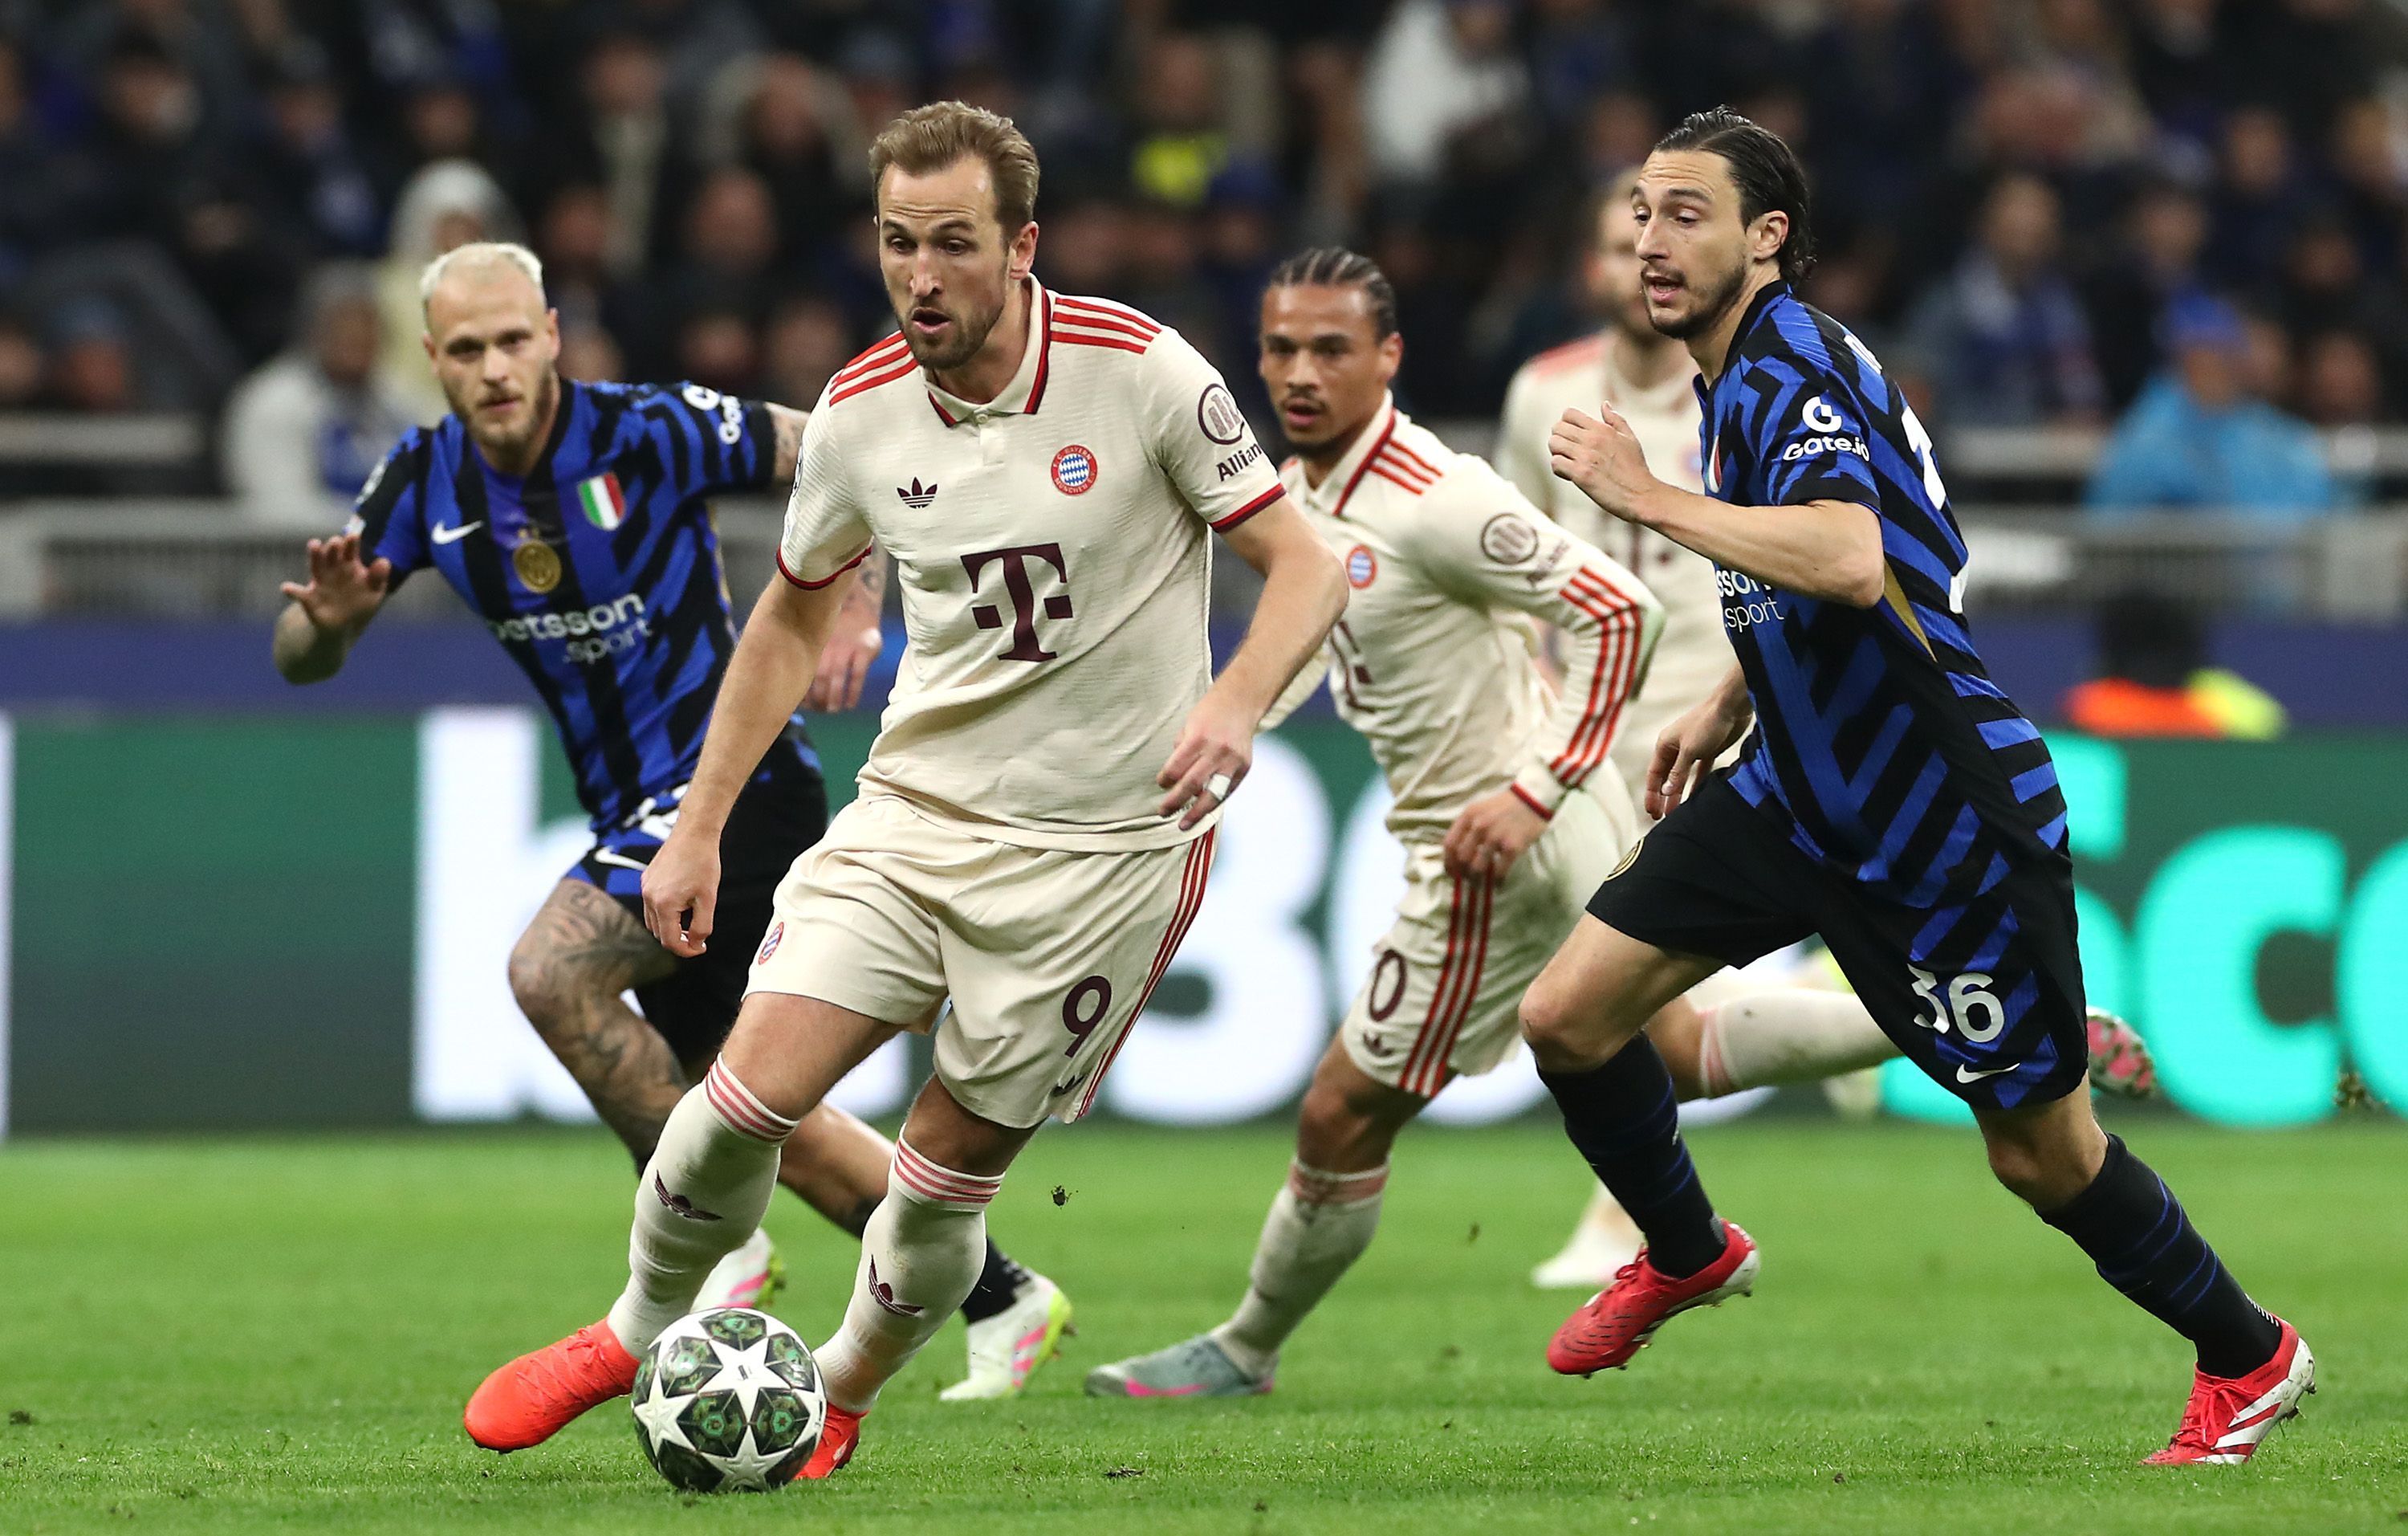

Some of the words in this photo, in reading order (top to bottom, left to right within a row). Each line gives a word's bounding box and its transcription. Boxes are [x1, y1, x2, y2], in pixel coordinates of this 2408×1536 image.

[1216, 443, 1263, 482] Allian
[1783, 436, 1870, 462] Gate.io
[488, 593, 645, 641] etsson
[960, 543, 1073, 662] T
[1063, 976, 1112, 1050] 9
[1369, 948, 1407, 1022] 0
[1907, 964, 2005, 1042] 36
